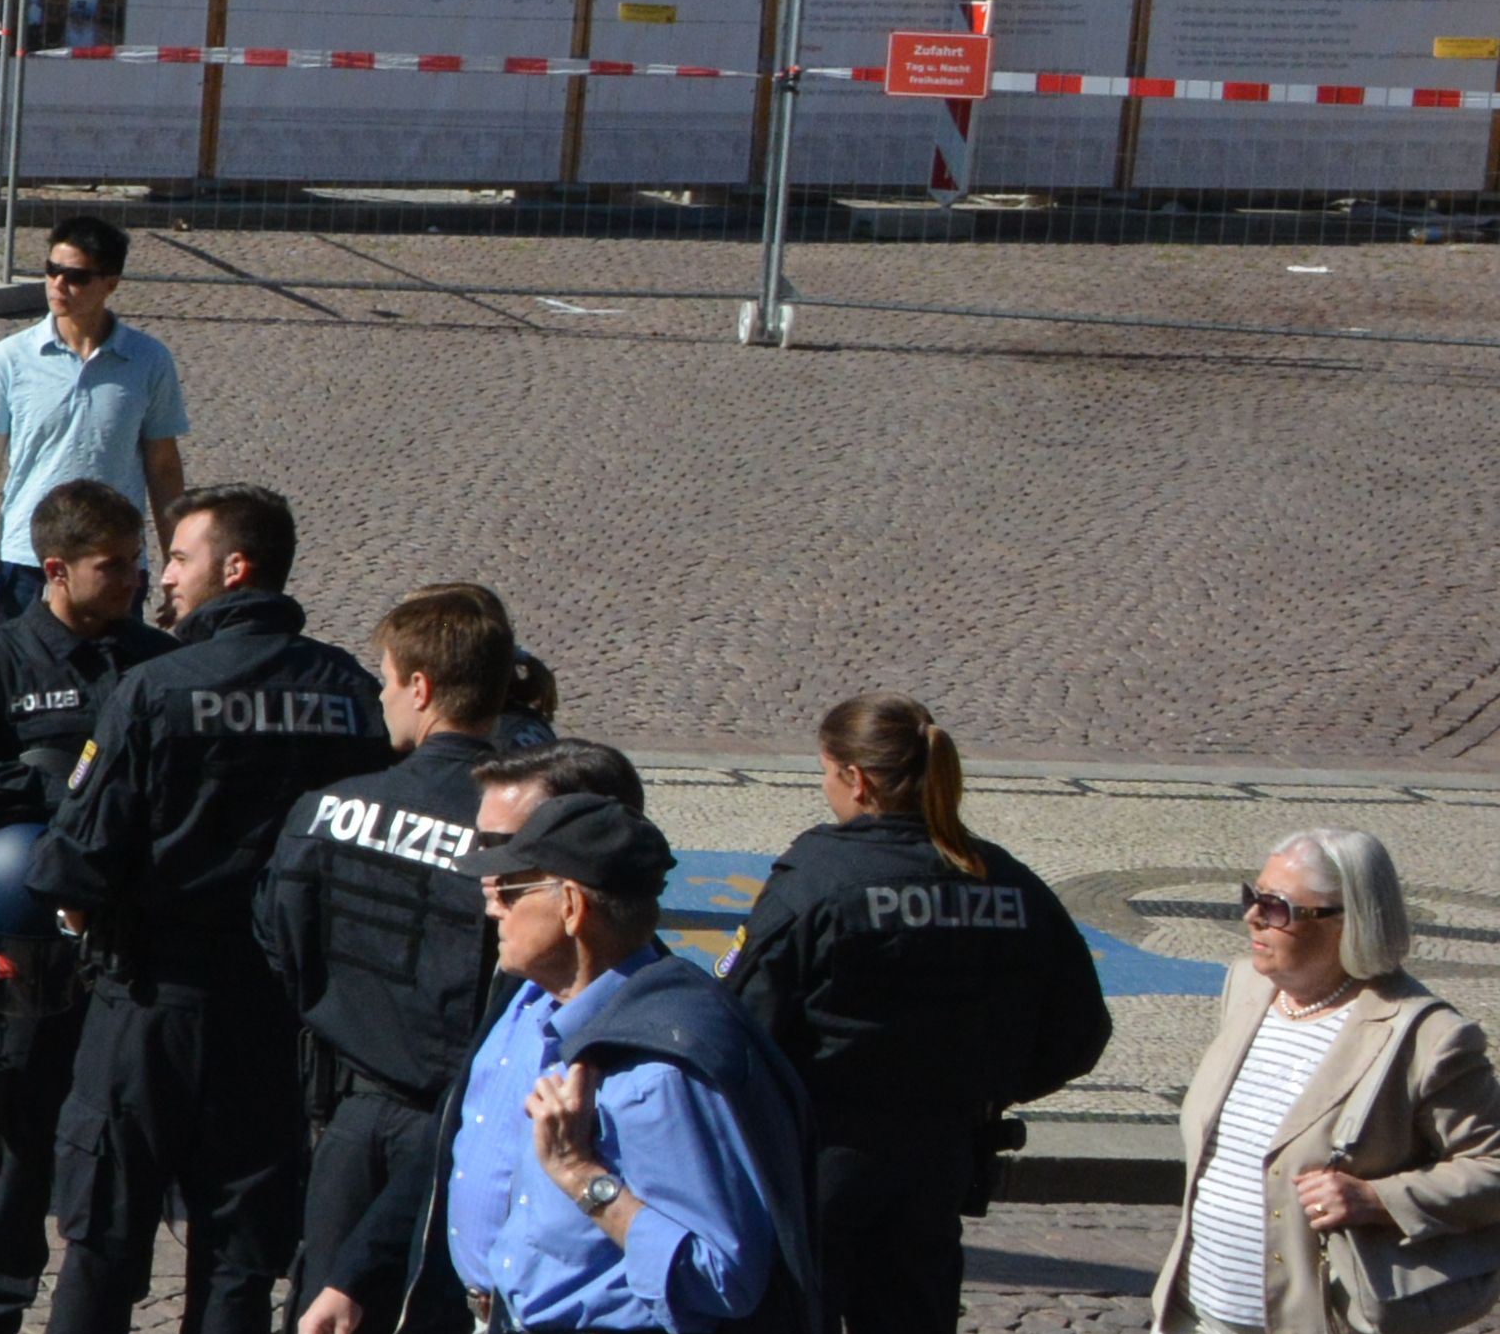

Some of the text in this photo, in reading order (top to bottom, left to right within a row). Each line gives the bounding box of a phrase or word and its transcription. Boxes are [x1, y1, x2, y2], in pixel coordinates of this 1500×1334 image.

[913, 44, 965, 58] Zufahrt
[905, 62, 925, 73] Tag
[940, 63, 972, 74] Nacht
[909, 75, 965, 86] freihalten!
[11, 688, 80, 712] POLIZEI
[191, 690, 359, 735] POLIZEI
[306, 794, 477, 871] POLIZEI
[866, 884, 1028, 931] POLIZEI
